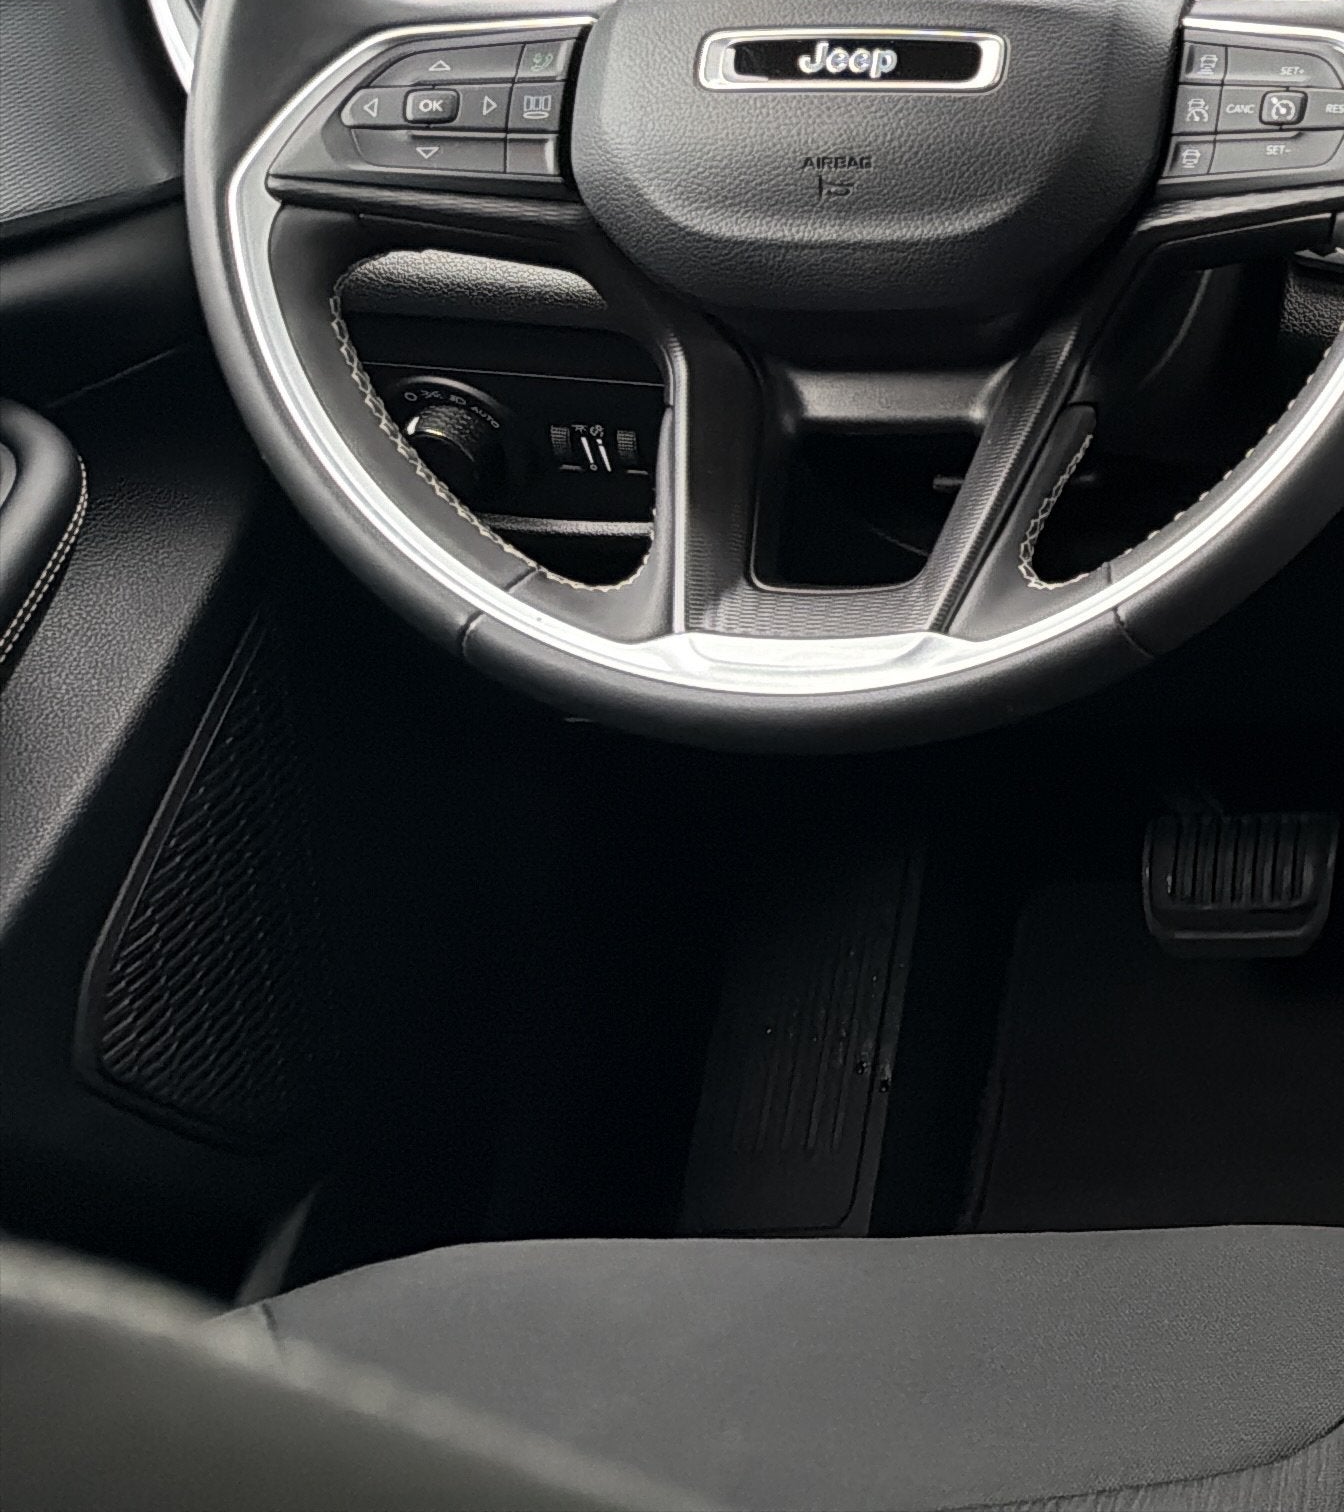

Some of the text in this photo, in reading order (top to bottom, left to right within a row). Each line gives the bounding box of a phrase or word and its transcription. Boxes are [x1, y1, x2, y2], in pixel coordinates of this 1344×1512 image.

[797, 41, 897, 79] Jeep
[418, 99, 443, 112] OK
[1226, 104, 1256, 114] CANC
[1325, 104, 1344, 114] RES
[802, 156, 873, 169] AIRBAG
